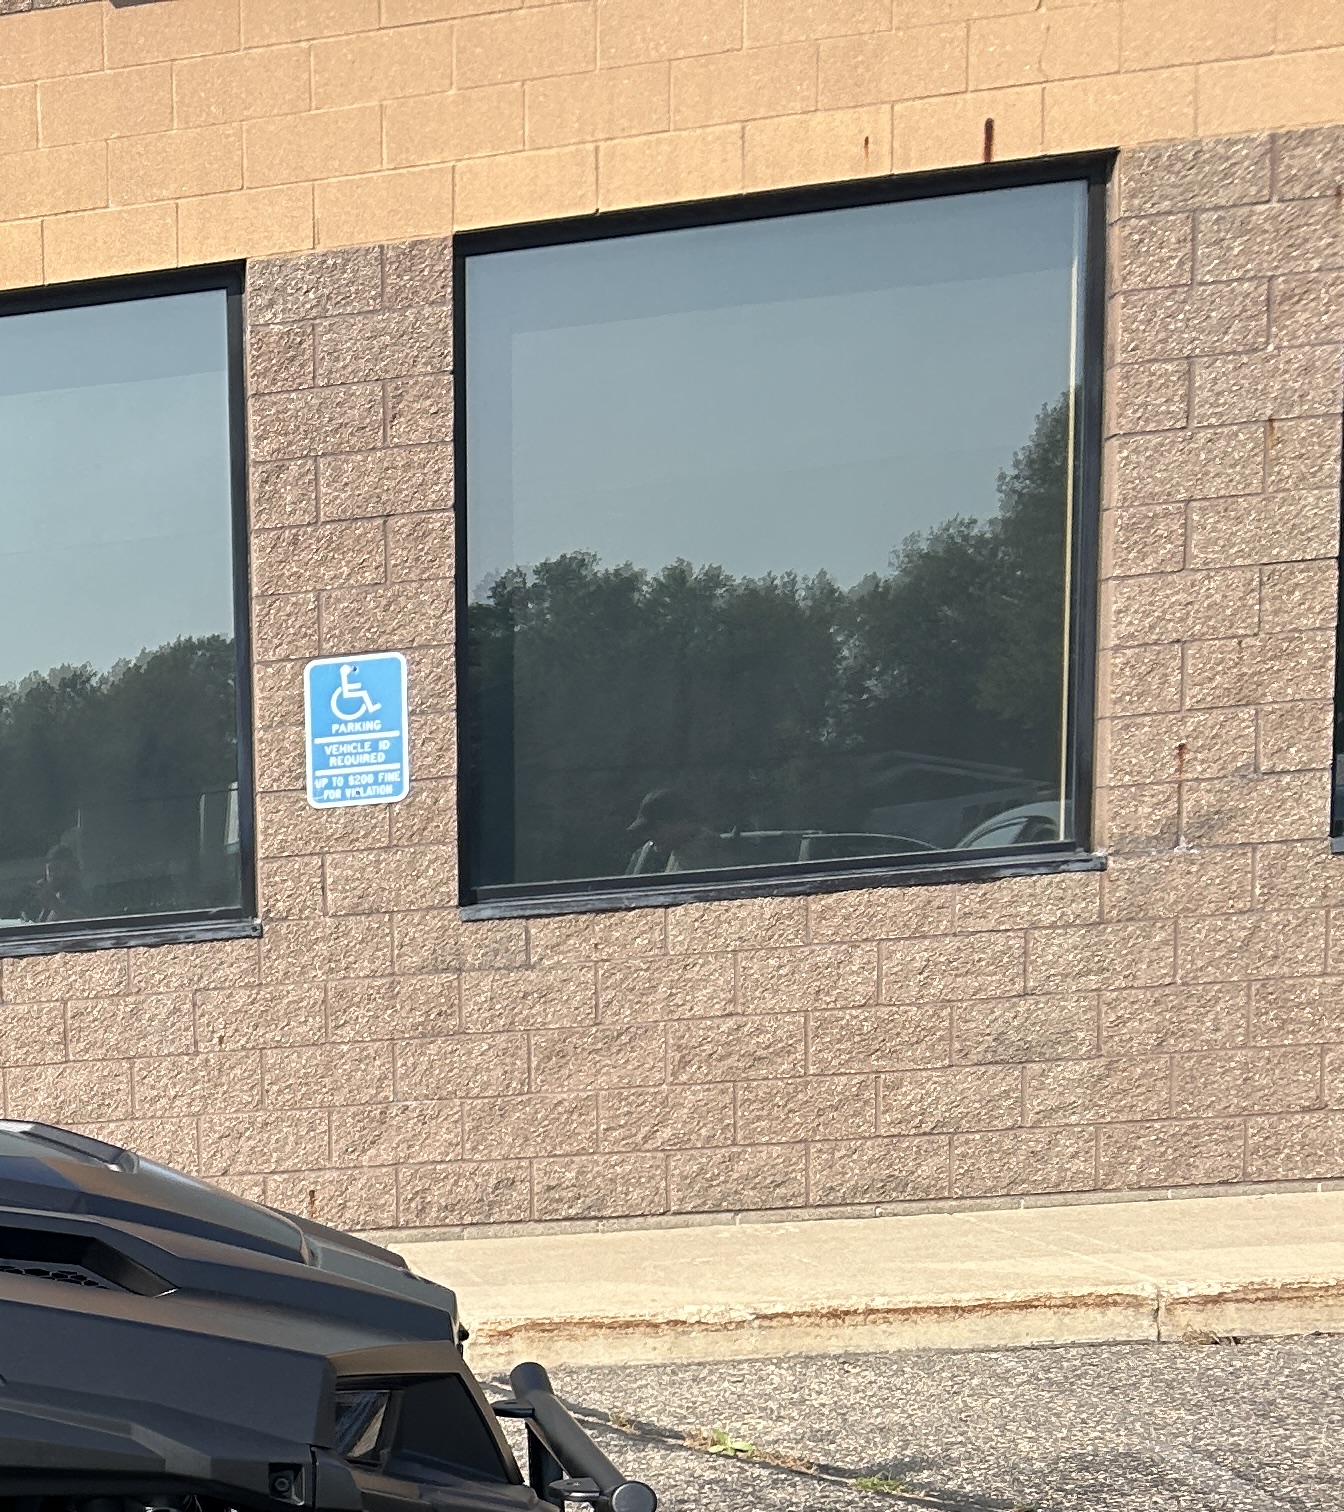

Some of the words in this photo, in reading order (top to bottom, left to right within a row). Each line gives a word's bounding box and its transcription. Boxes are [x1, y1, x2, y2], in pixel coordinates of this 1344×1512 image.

[331, 719, 382, 735] PARKING
[324, 741, 372, 755] VEHICLE
[378, 739, 391, 750] ID
[329, 752, 386, 767] REQUIRED
[315, 777, 327, 789] UP
[332, 775, 344, 786] TO
[348, 774, 375, 786] $200
[378, 771, 401, 783] FINE
[323, 788, 342, 800] FOR
[345, 784, 393, 799] VIOLATION
